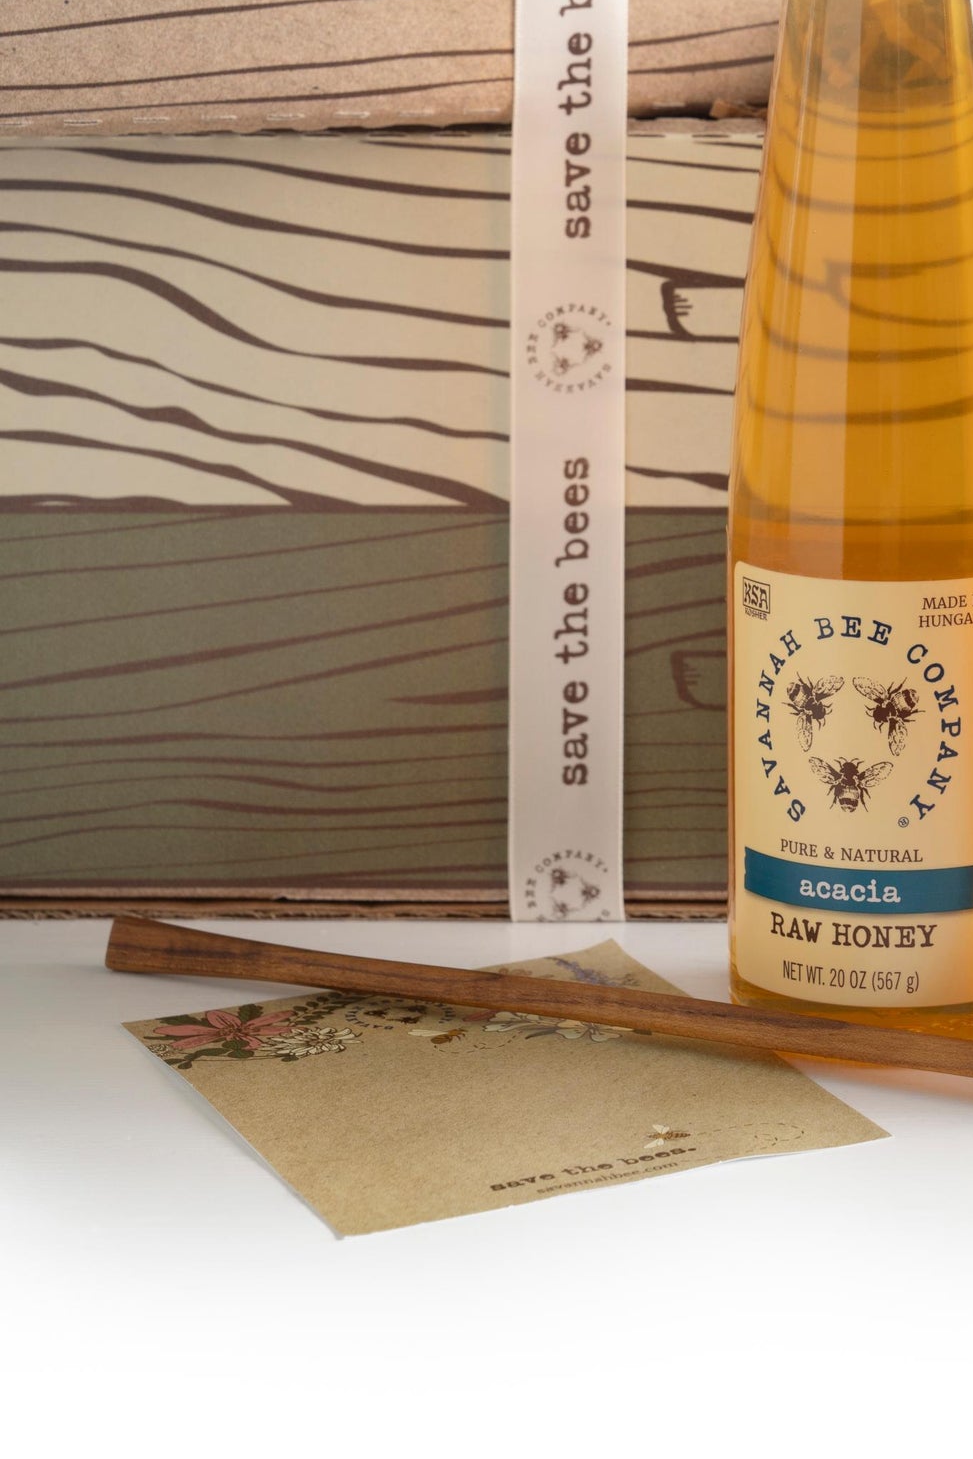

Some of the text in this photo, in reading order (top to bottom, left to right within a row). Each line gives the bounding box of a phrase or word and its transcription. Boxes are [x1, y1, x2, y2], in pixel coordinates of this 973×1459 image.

[557, 32, 593, 116] the
[564, 132, 592, 239] save
[743, 581, 769, 610] KSA
[921, 595, 968, 611] MADE
[553, 457, 590, 786] save the bees
[744, 607, 768, 621] KOSHER
[755, 615, 961, 822] SAVANNAH BEE COMPANY
[780, 839, 923, 863] PURE & NATURAL
[799, 878, 901, 903] acacia
[770, 912, 938, 948] RAW HONEY
[782, 960, 920, 993] NET WT. 20 OZ (567 g)
[490, 1147, 697, 1192] save the bees.
[536, 1161, 679, 1195] savannahbee.com
